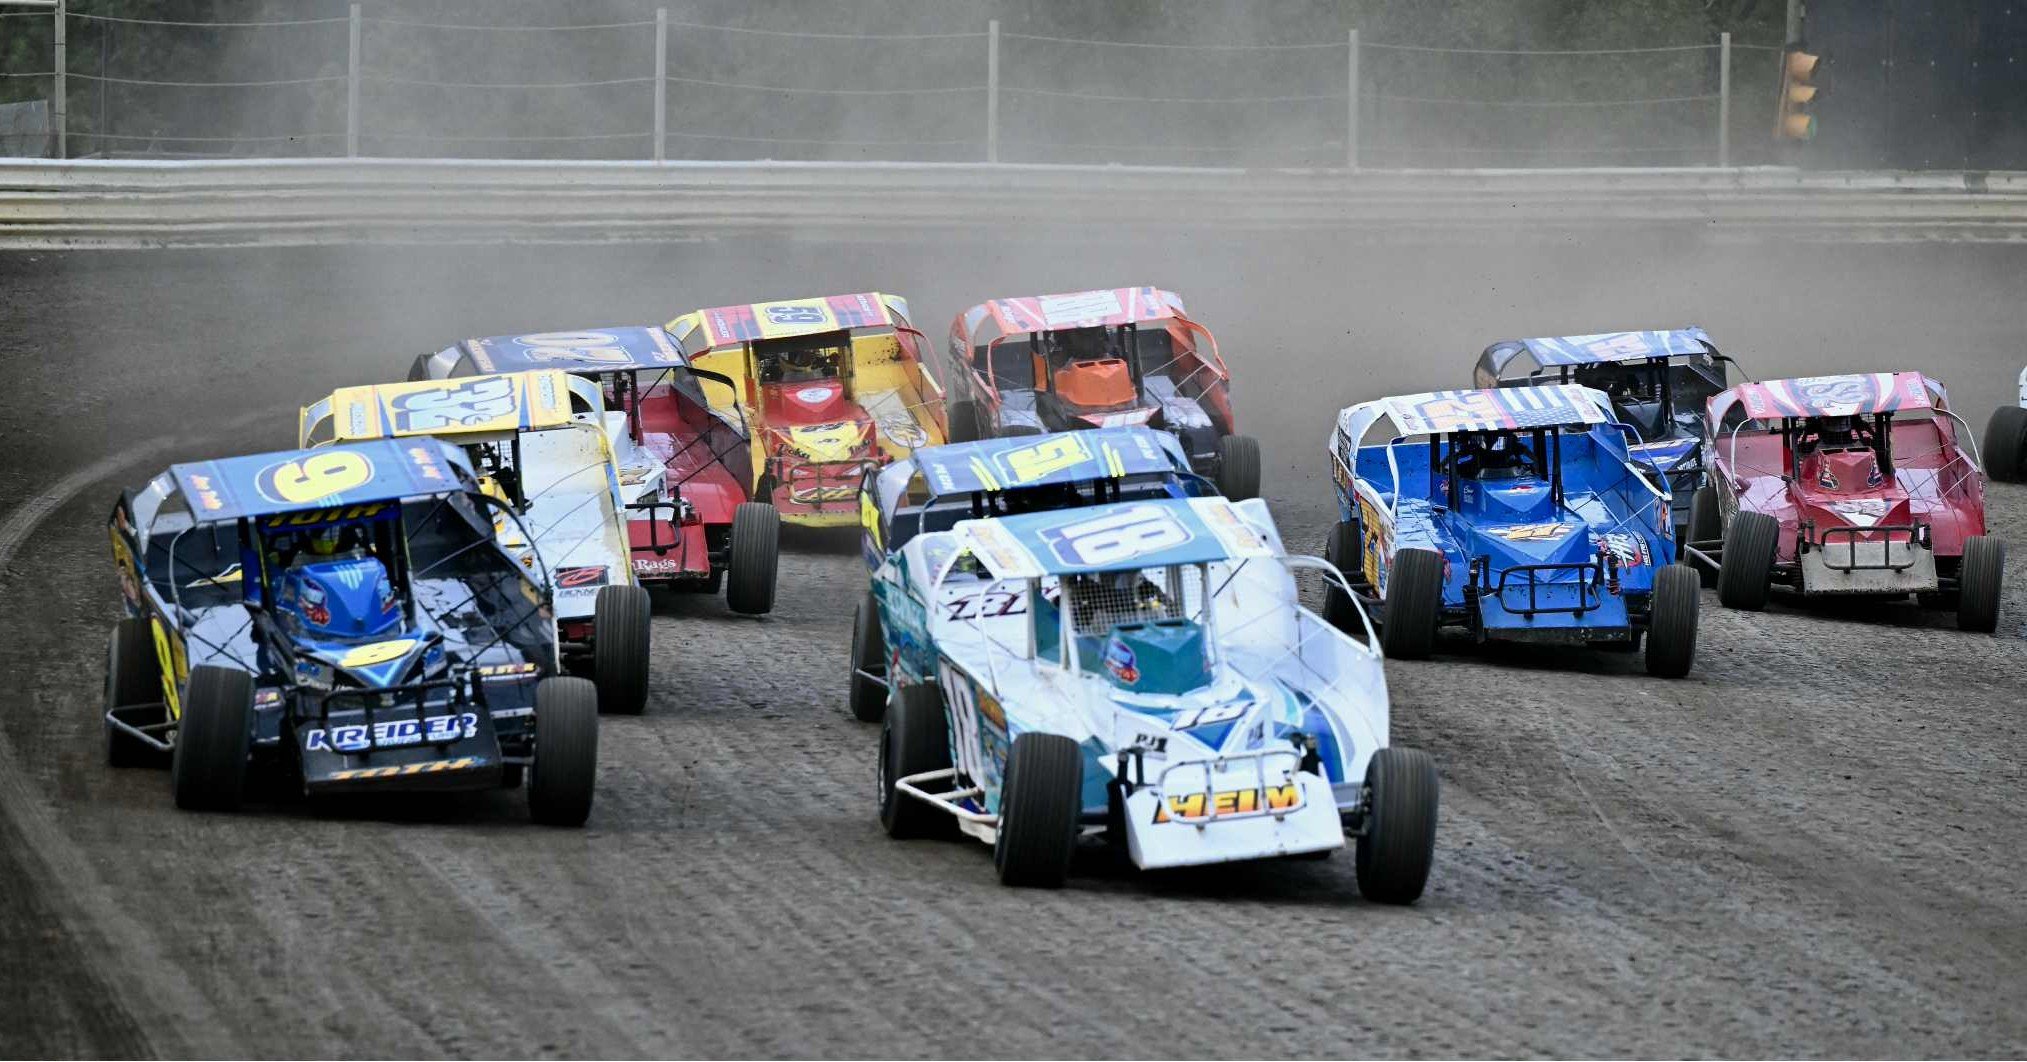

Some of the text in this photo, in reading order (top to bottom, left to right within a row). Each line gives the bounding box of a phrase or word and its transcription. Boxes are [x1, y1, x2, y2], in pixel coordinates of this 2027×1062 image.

[764, 305, 827, 325] 59
[1042, 503, 1193, 566] 18
[306, 713, 478, 752] KREIDER
[1170, 701, 1255, 731] 18
[1134, 732, 1168, 753] PJ1
[1152, 782, 1301, 825] HEIM
